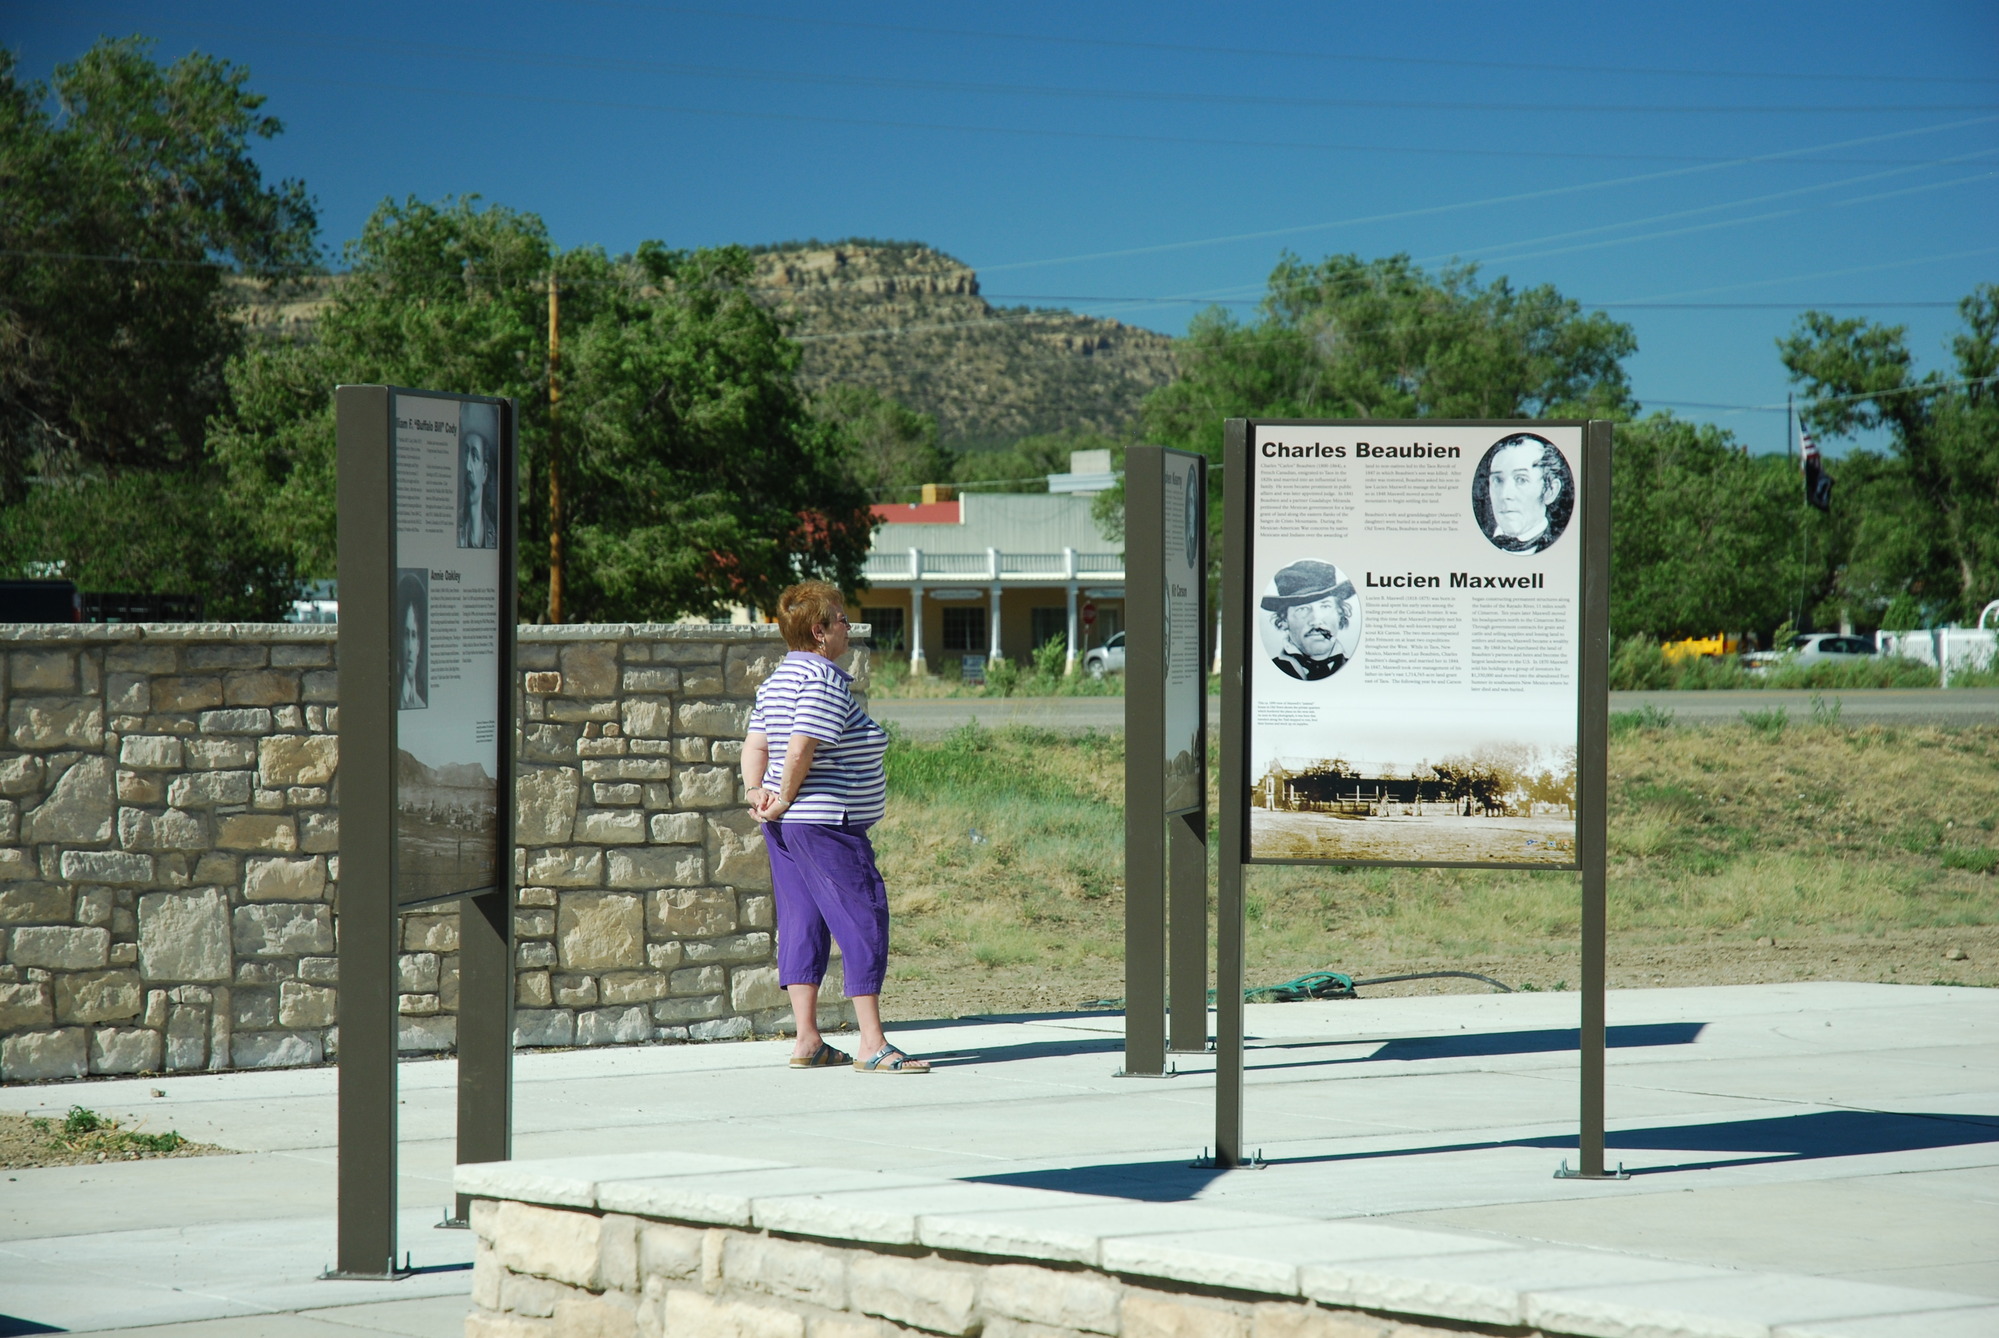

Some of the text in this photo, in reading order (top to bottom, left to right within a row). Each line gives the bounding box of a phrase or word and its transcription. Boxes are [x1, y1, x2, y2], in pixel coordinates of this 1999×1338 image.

[1262, 442, 1460, 458] Charles Beaubien
[445, 570, 460, 584] Oakley
[1366, 572, 1544, 588] Lucien Maxwell
